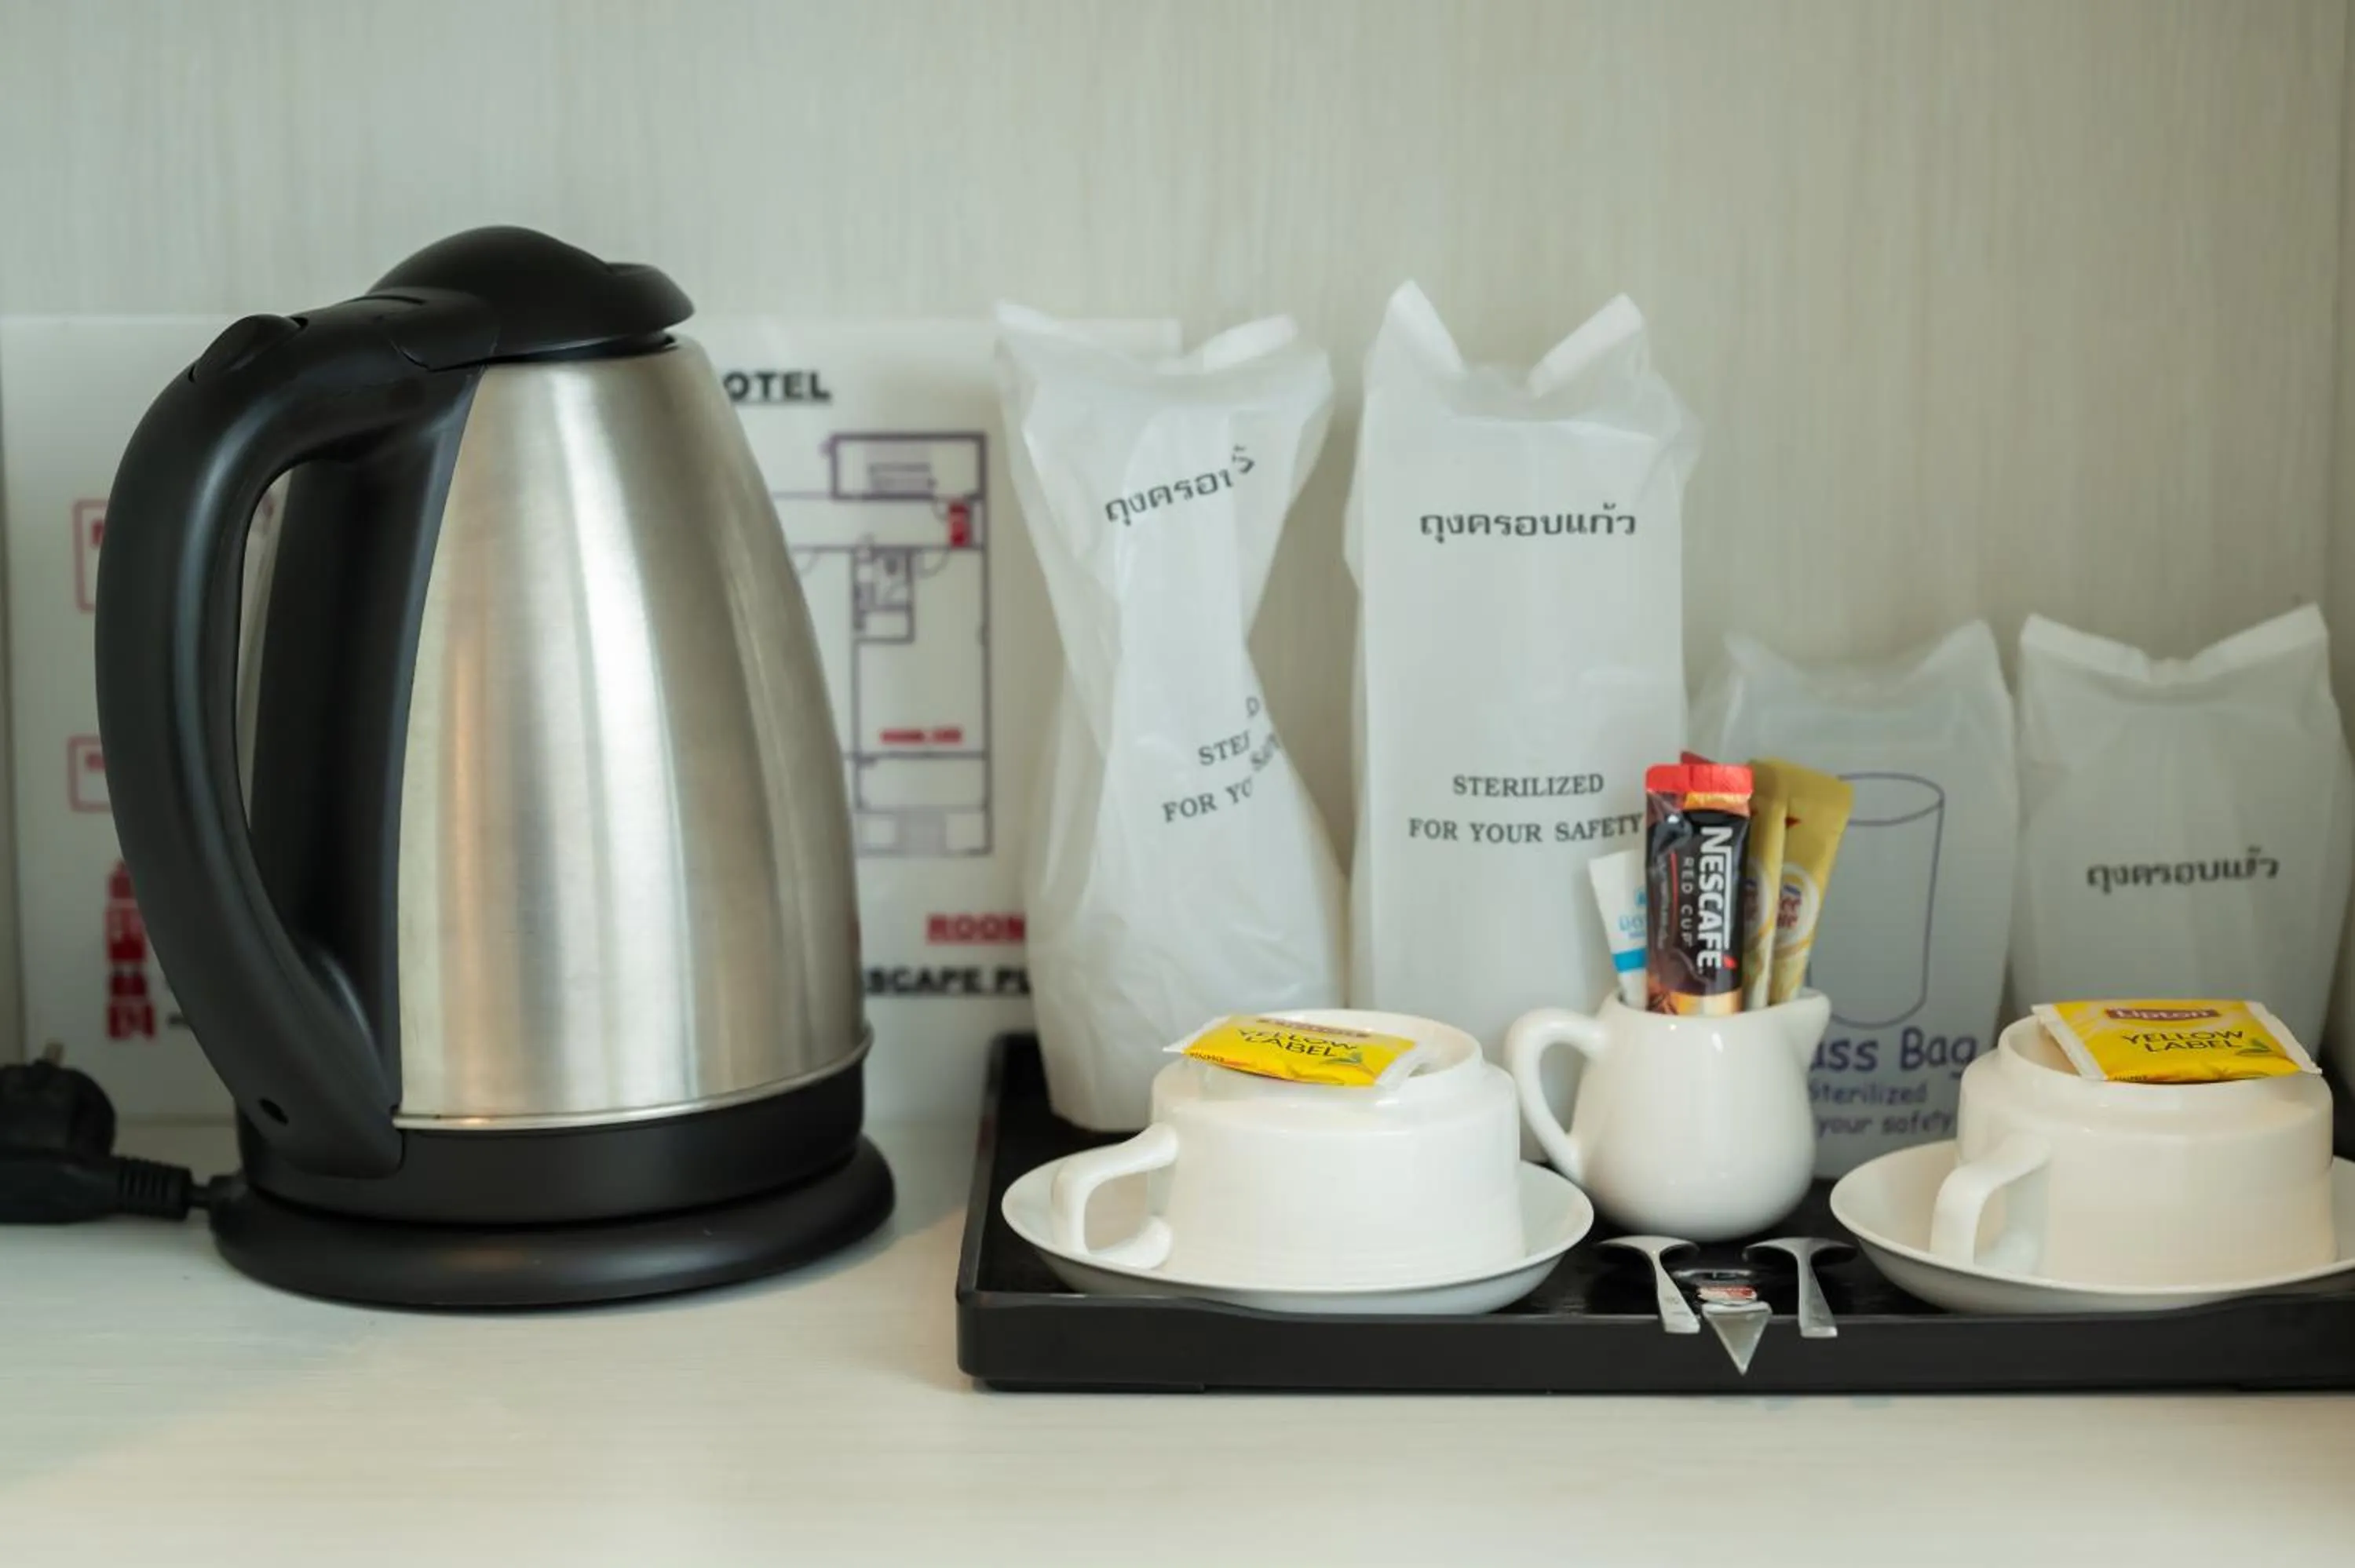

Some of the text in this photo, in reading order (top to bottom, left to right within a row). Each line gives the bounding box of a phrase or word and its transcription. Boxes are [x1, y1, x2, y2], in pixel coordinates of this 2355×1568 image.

[723, 370, 831, 402] OTEL
[1420, 502, 1637, 544] ถุงครอบแก้ว
[1453, 773, 1605, 797] STERILIZED
[1162, 793, 1218, 823] FOR
[1409, 811, 1644, 843] FOR YOUR SAFETY
[1681, 856, 1695, 945] RED CUP
[865, 966, 983, 994] SCAPE
[1236, 1028, 1357, 1050] YELLOW
[1243, 1034, 1339, 1058] LABEL
[2120, 1030, 2244, 1045] YELLOW
[2144, 1039, 2243, 1052] LABEL
[1900, 1026, 1978, 1080] Bag
